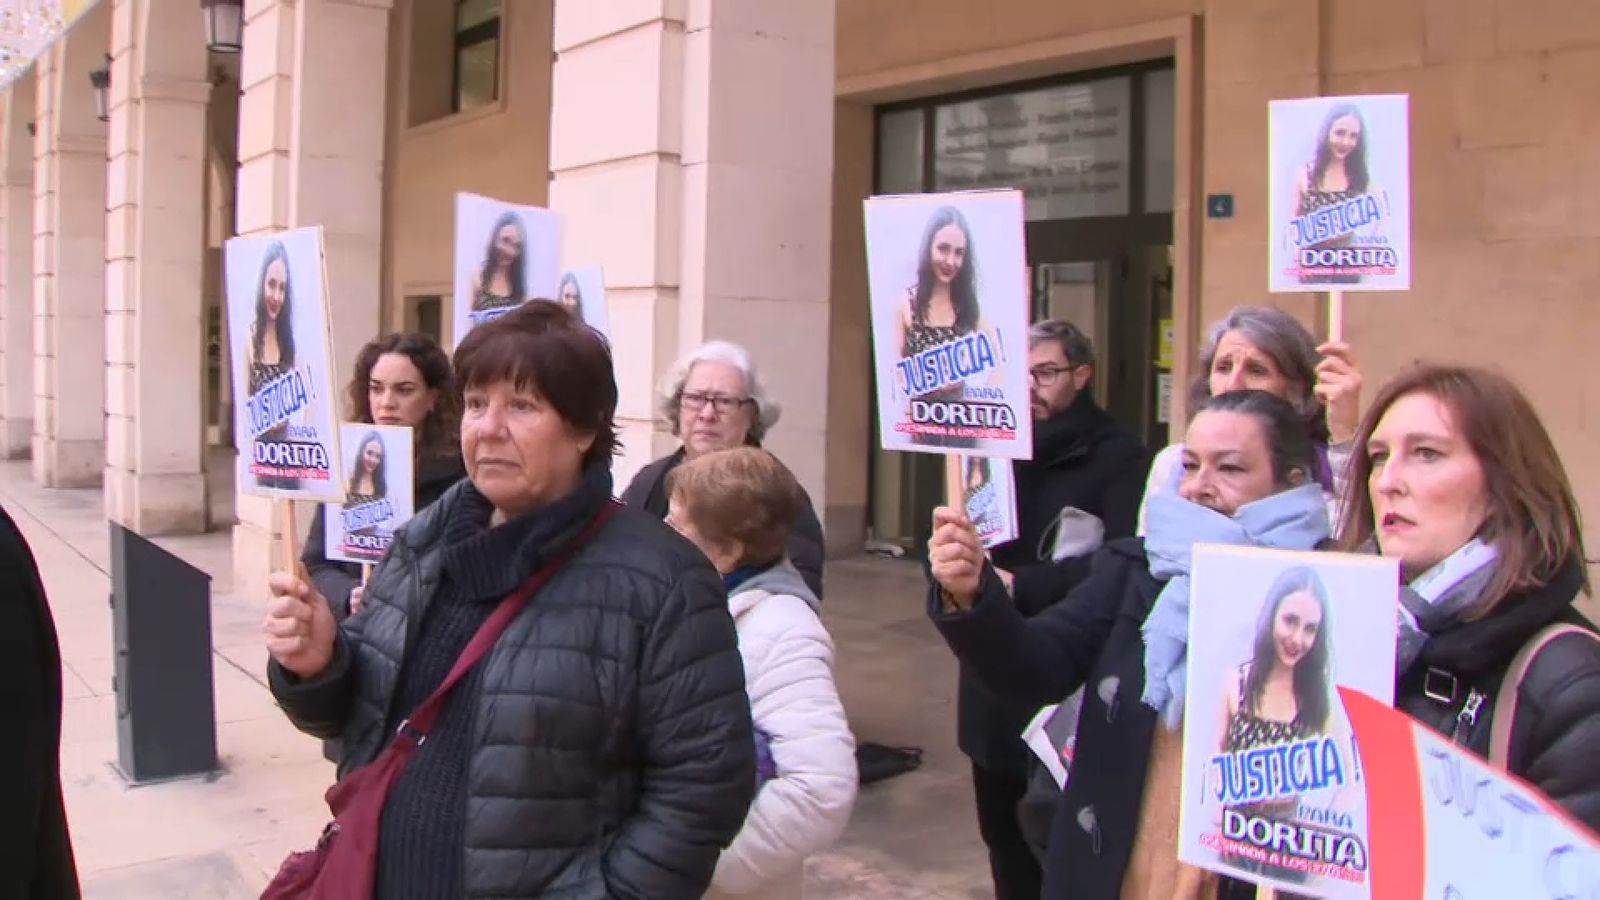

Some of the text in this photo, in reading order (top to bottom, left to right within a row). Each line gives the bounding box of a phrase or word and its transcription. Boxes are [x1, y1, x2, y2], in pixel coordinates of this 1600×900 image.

[1290, 195, 1380, 246] JUSTICIA
[1300, 247, 1399, 268] DORITA
[897, 332, 994, 396] JUSTICIA
[246, 371, 308, 434] JUSTICIA
[964, 386, 1005, 399] PARA
[912, 399, 1017, 430] DORITA
[253, 441, 329, 469] DORITA
[1212, 737, 1343, 803] JUSTICIA
[1298, 805, 1353, 830] PARA
[1222, 806, 1367, 872] DORITA
